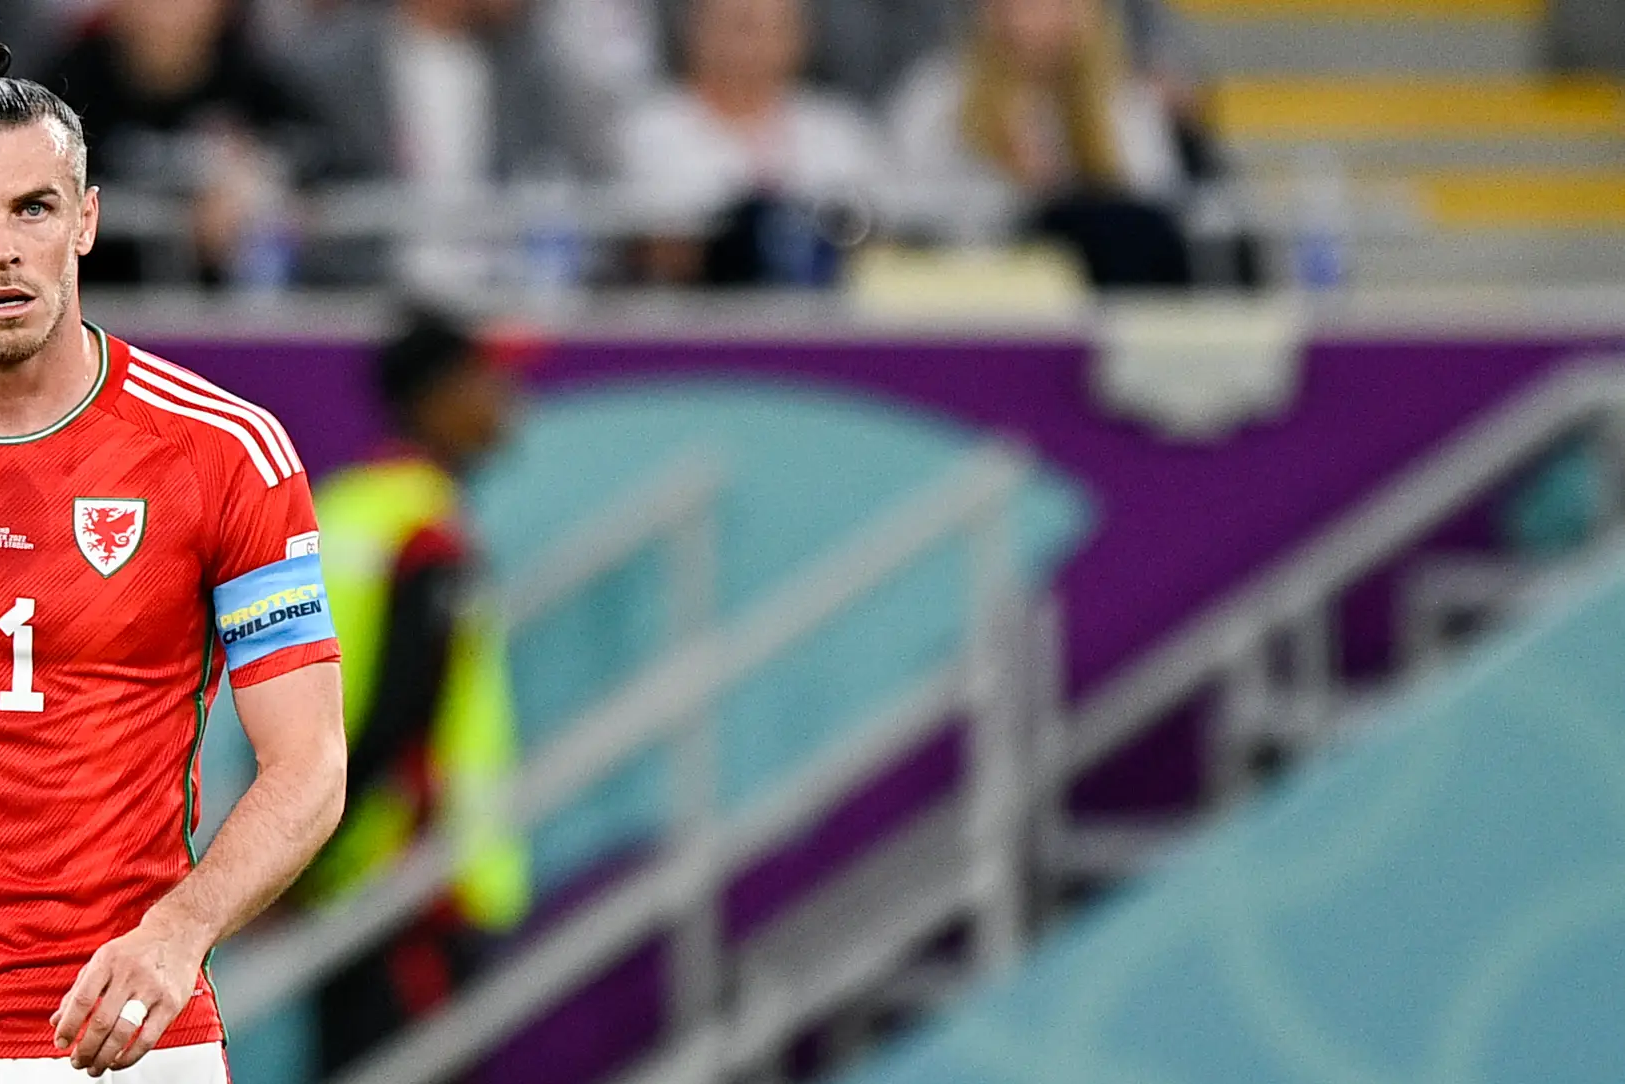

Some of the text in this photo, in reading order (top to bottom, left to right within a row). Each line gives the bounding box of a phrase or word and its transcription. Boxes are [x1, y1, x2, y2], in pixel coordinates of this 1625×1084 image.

[8, 534, 27, 543] 2022
[220, 584, 318, 629] PROTECT
[222, 599, 322, 645] CHILDREN
